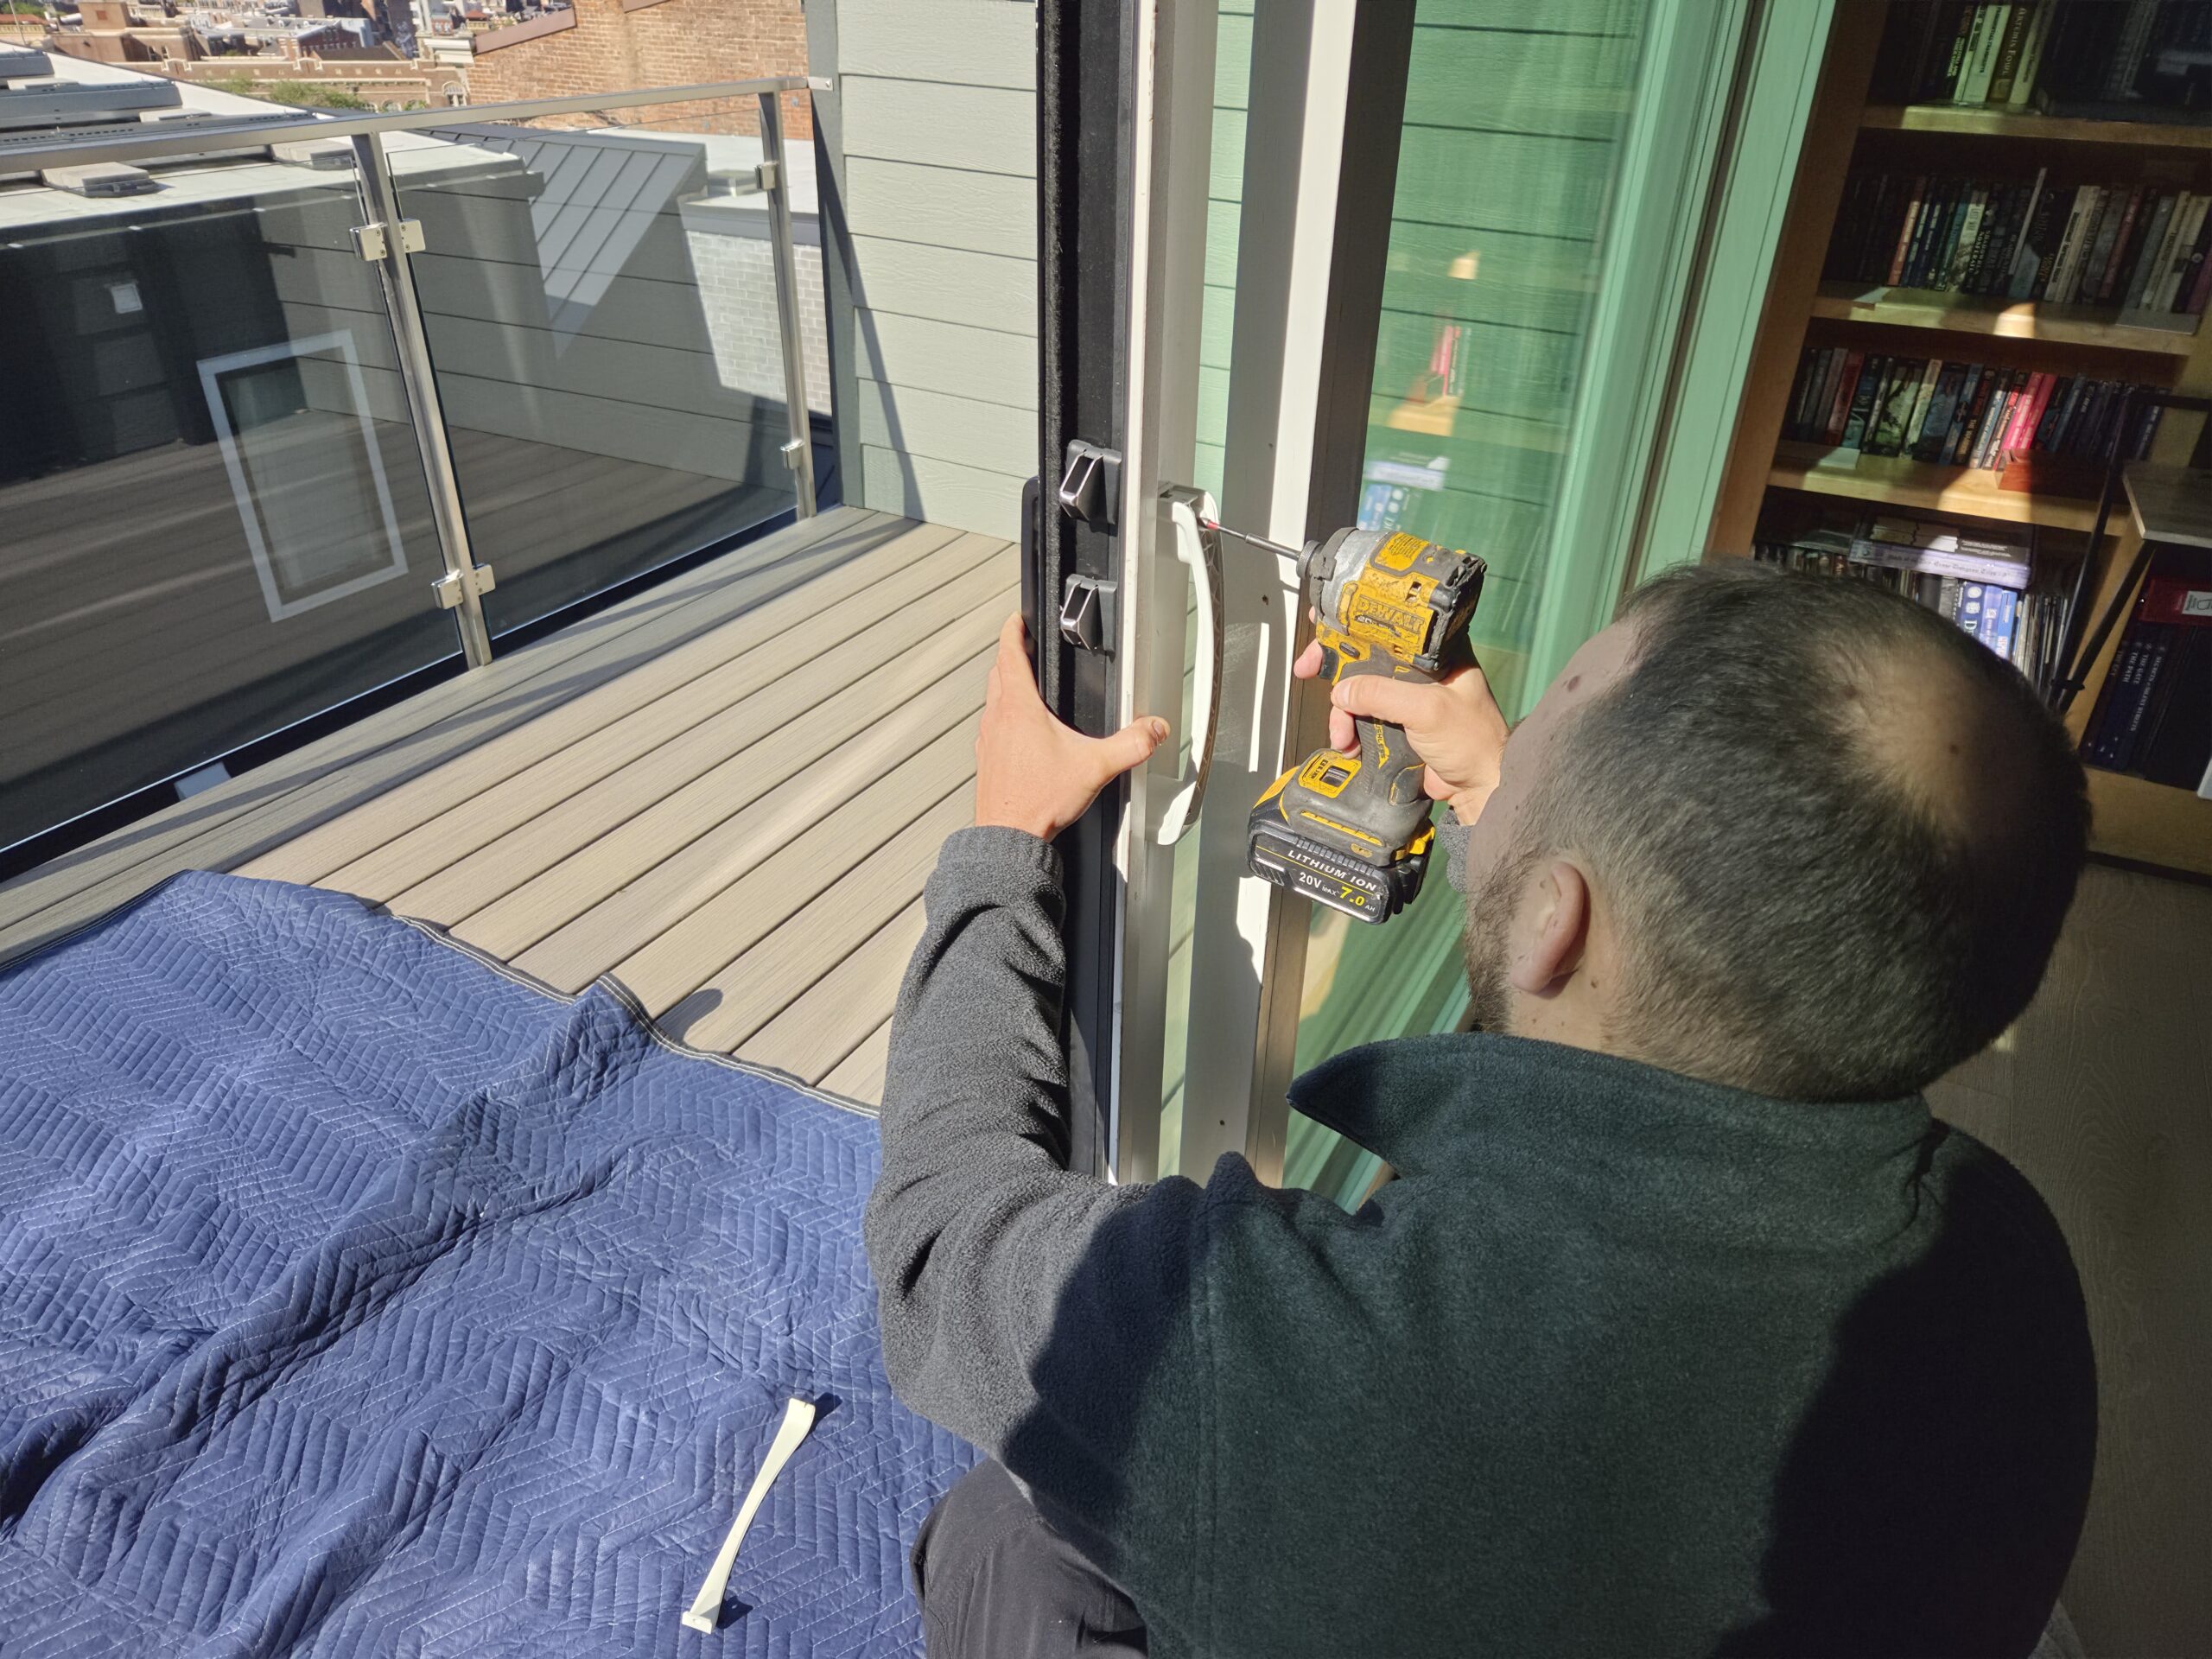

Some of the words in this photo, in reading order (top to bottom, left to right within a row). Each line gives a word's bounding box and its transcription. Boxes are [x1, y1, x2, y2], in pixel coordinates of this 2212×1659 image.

[2002, 49, 2016, 76] FOWL
[2127, 651, 2139, 665] THE
[2139, 652, 2149, 667] THE
[2122, 664, 2134, 683] PATH
[1287, 849, 1348, 880] LITHIUM
[1350, 875, 1377, 891] ION
[1299, 872, 1322, 888] 20V
[1339, 886, 1365, 906] 7.0
